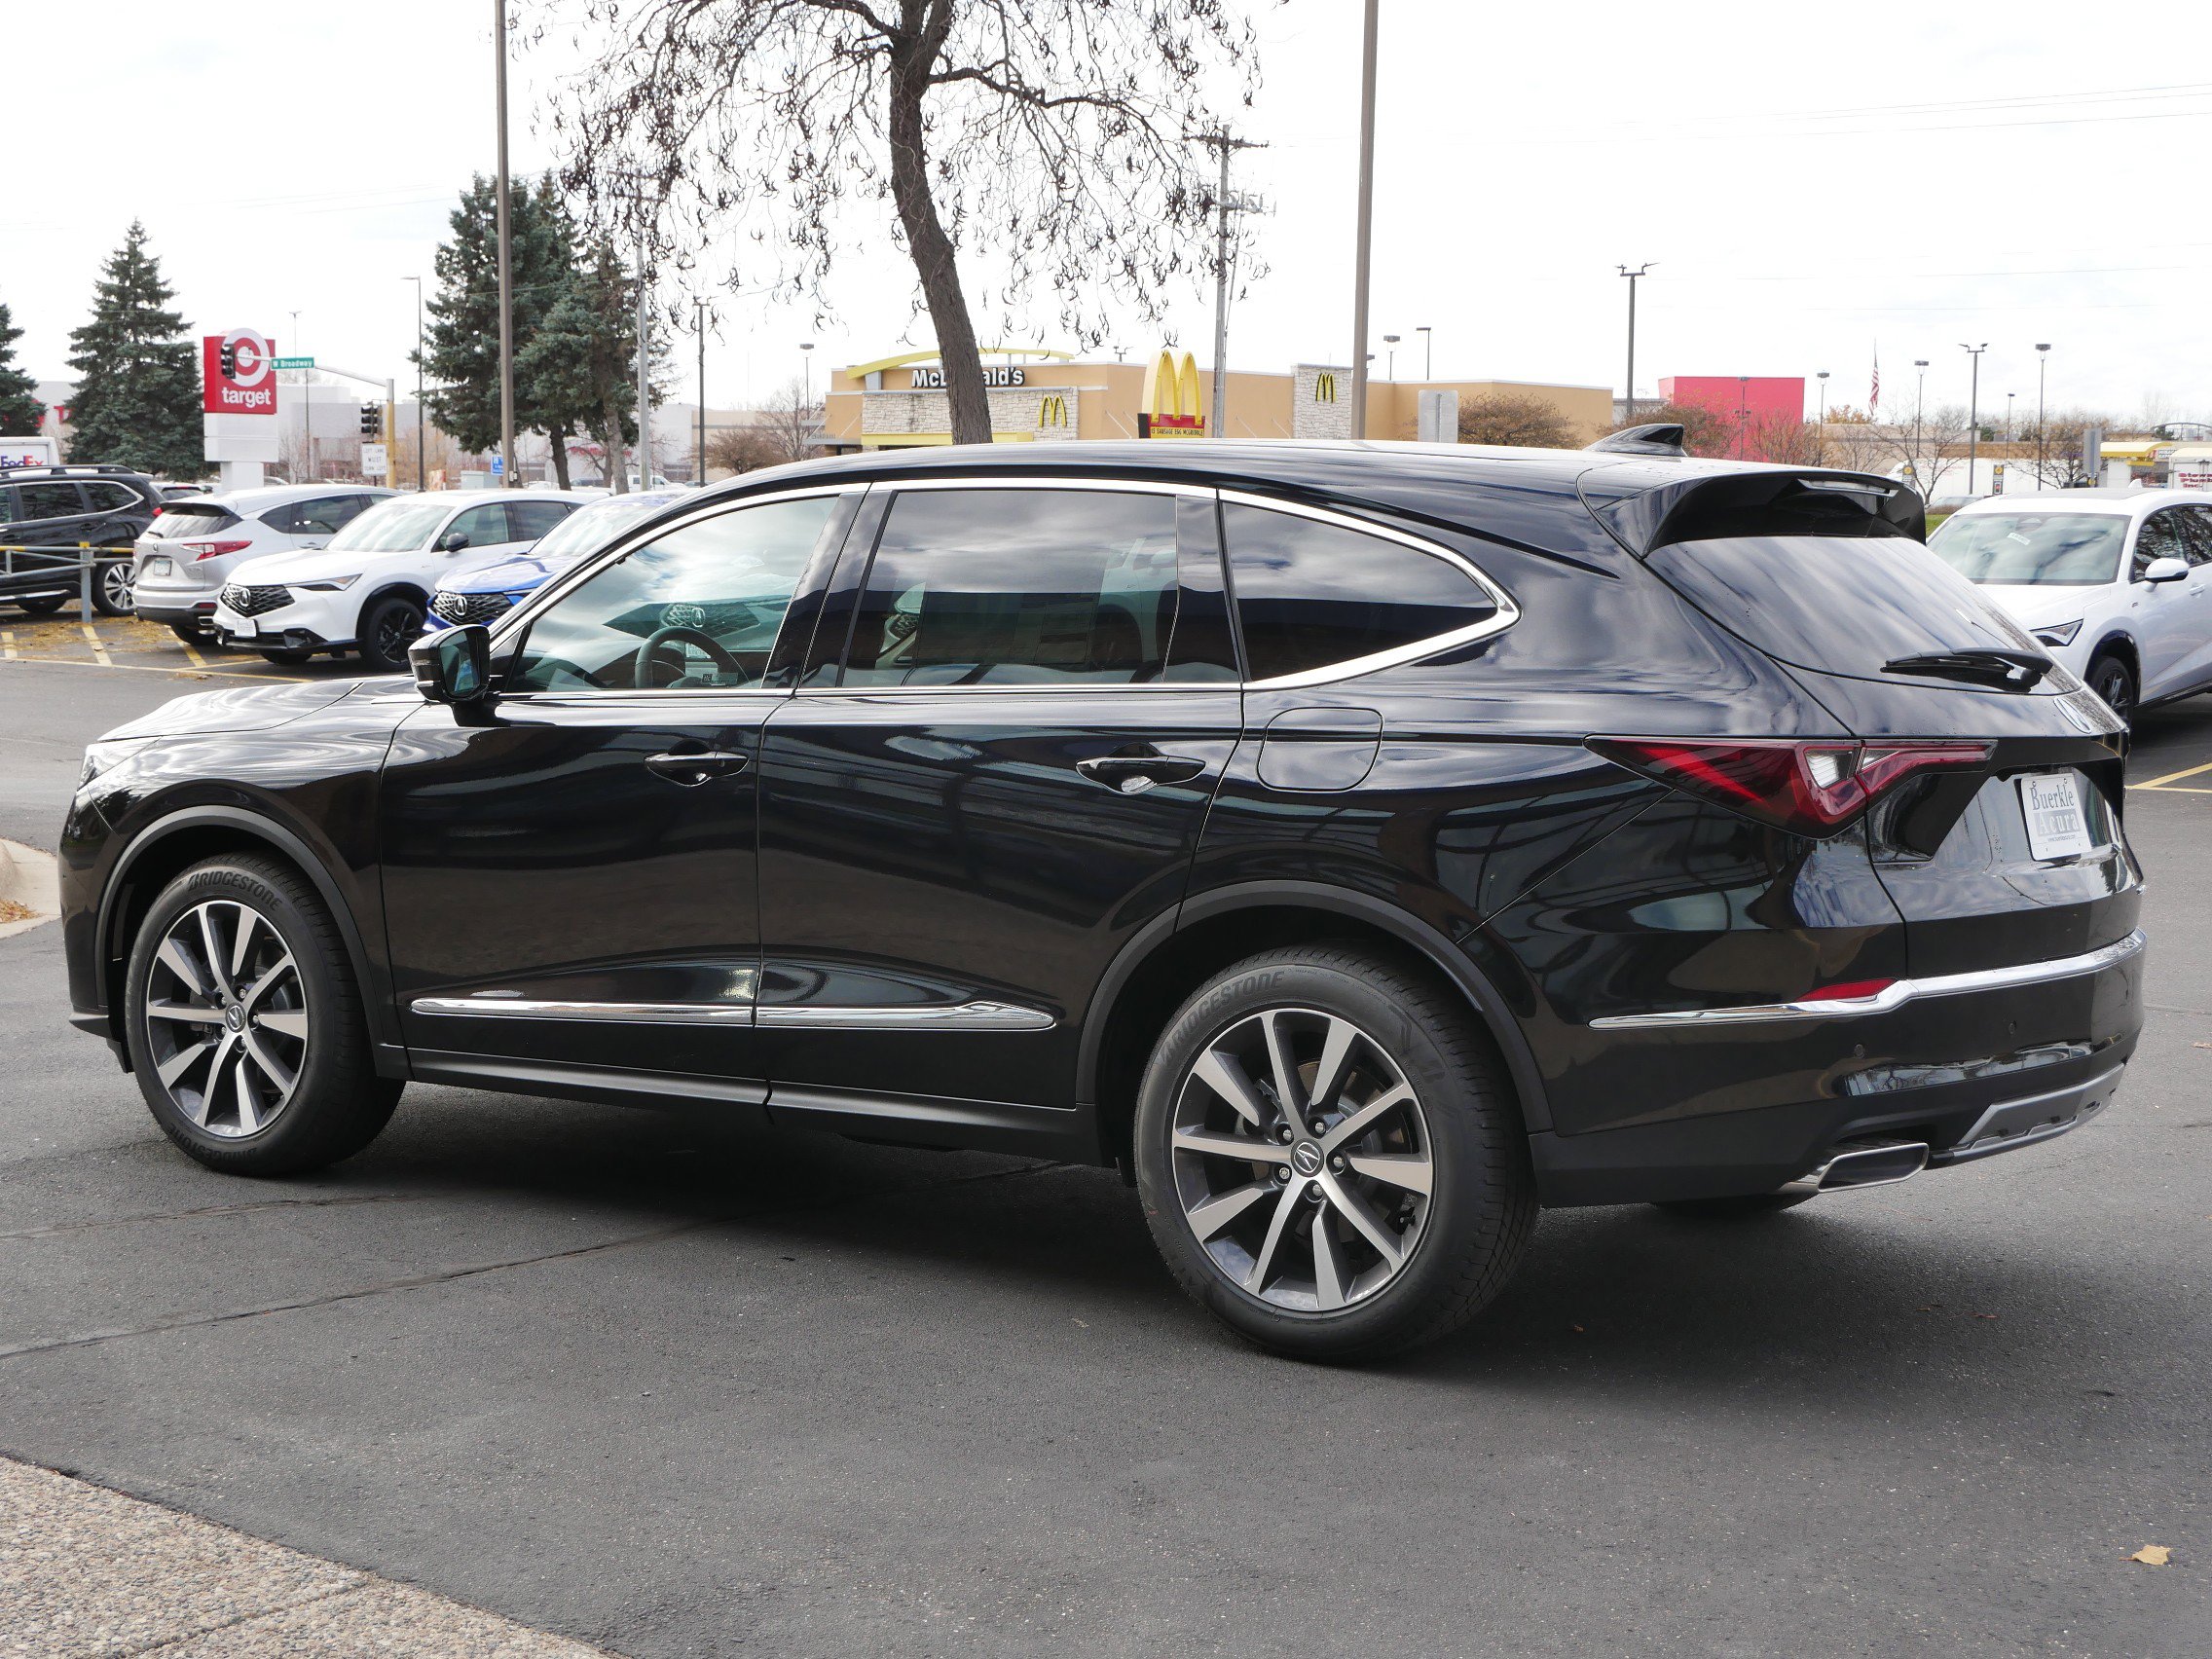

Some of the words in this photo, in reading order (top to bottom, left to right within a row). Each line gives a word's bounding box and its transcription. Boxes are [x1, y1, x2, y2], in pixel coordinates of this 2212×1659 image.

[280, 359, 313, 368] Broadway
[911, 367, 1024, 387] McDald's
[221, 387, 272, 409] target
[2029, 784, 2075, 811] Buerkle
[2039, 813, 2080, 834] Acura
[188, 870, 283, 911] BRIDGESTONE
